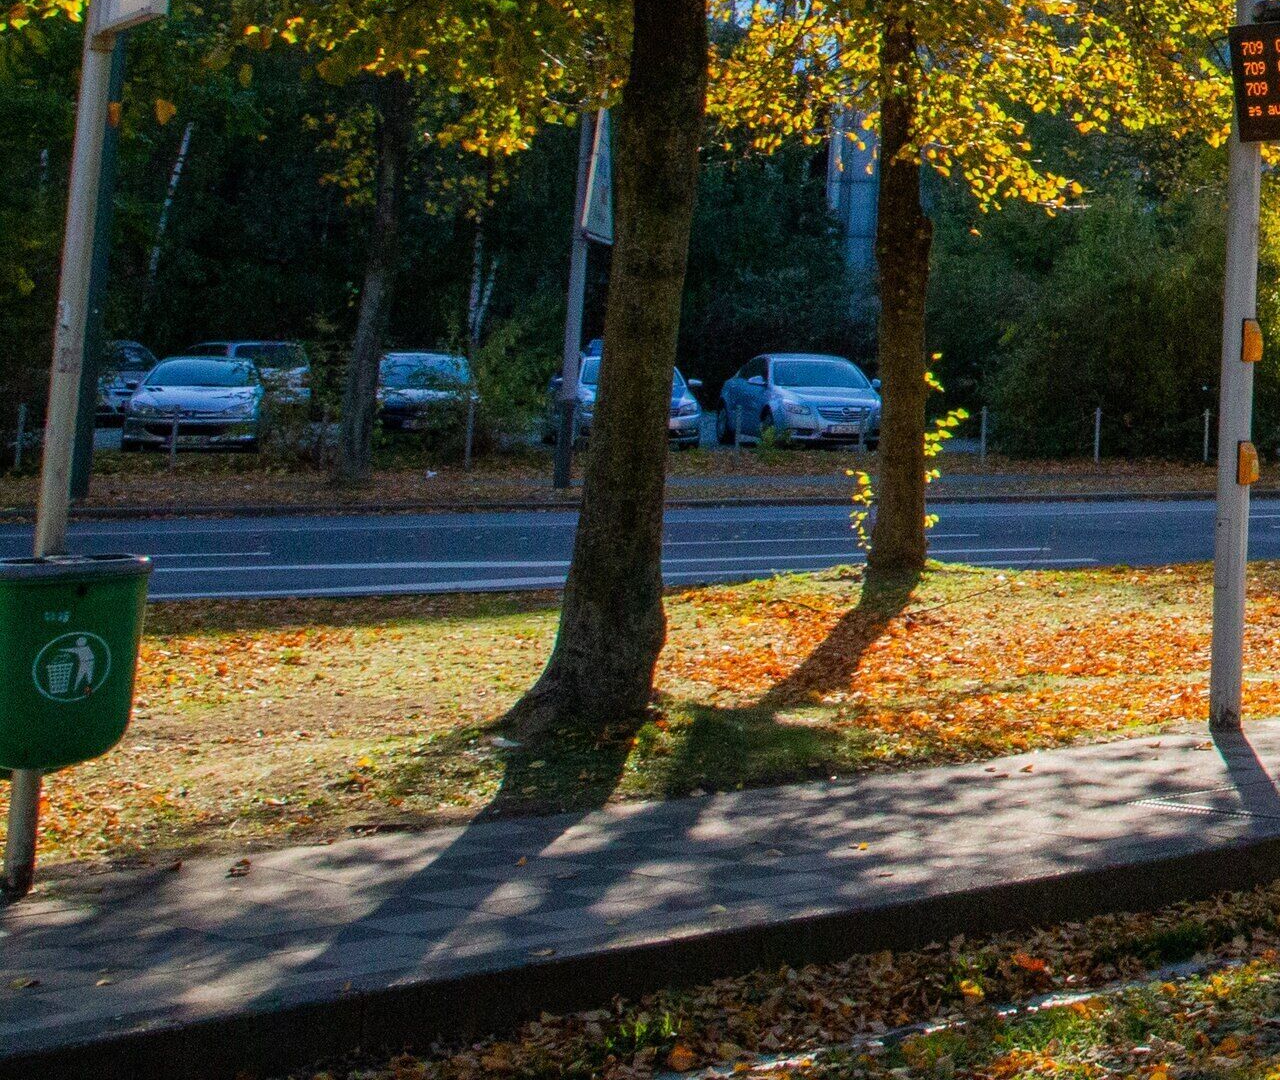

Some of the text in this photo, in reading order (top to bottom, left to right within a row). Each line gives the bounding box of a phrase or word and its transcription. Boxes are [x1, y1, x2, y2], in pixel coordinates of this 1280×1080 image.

[1241, 41, 1264, 56] 709
[1243, 61, 1266, 75] 709
[1246, 82, 1268, 96] 709
